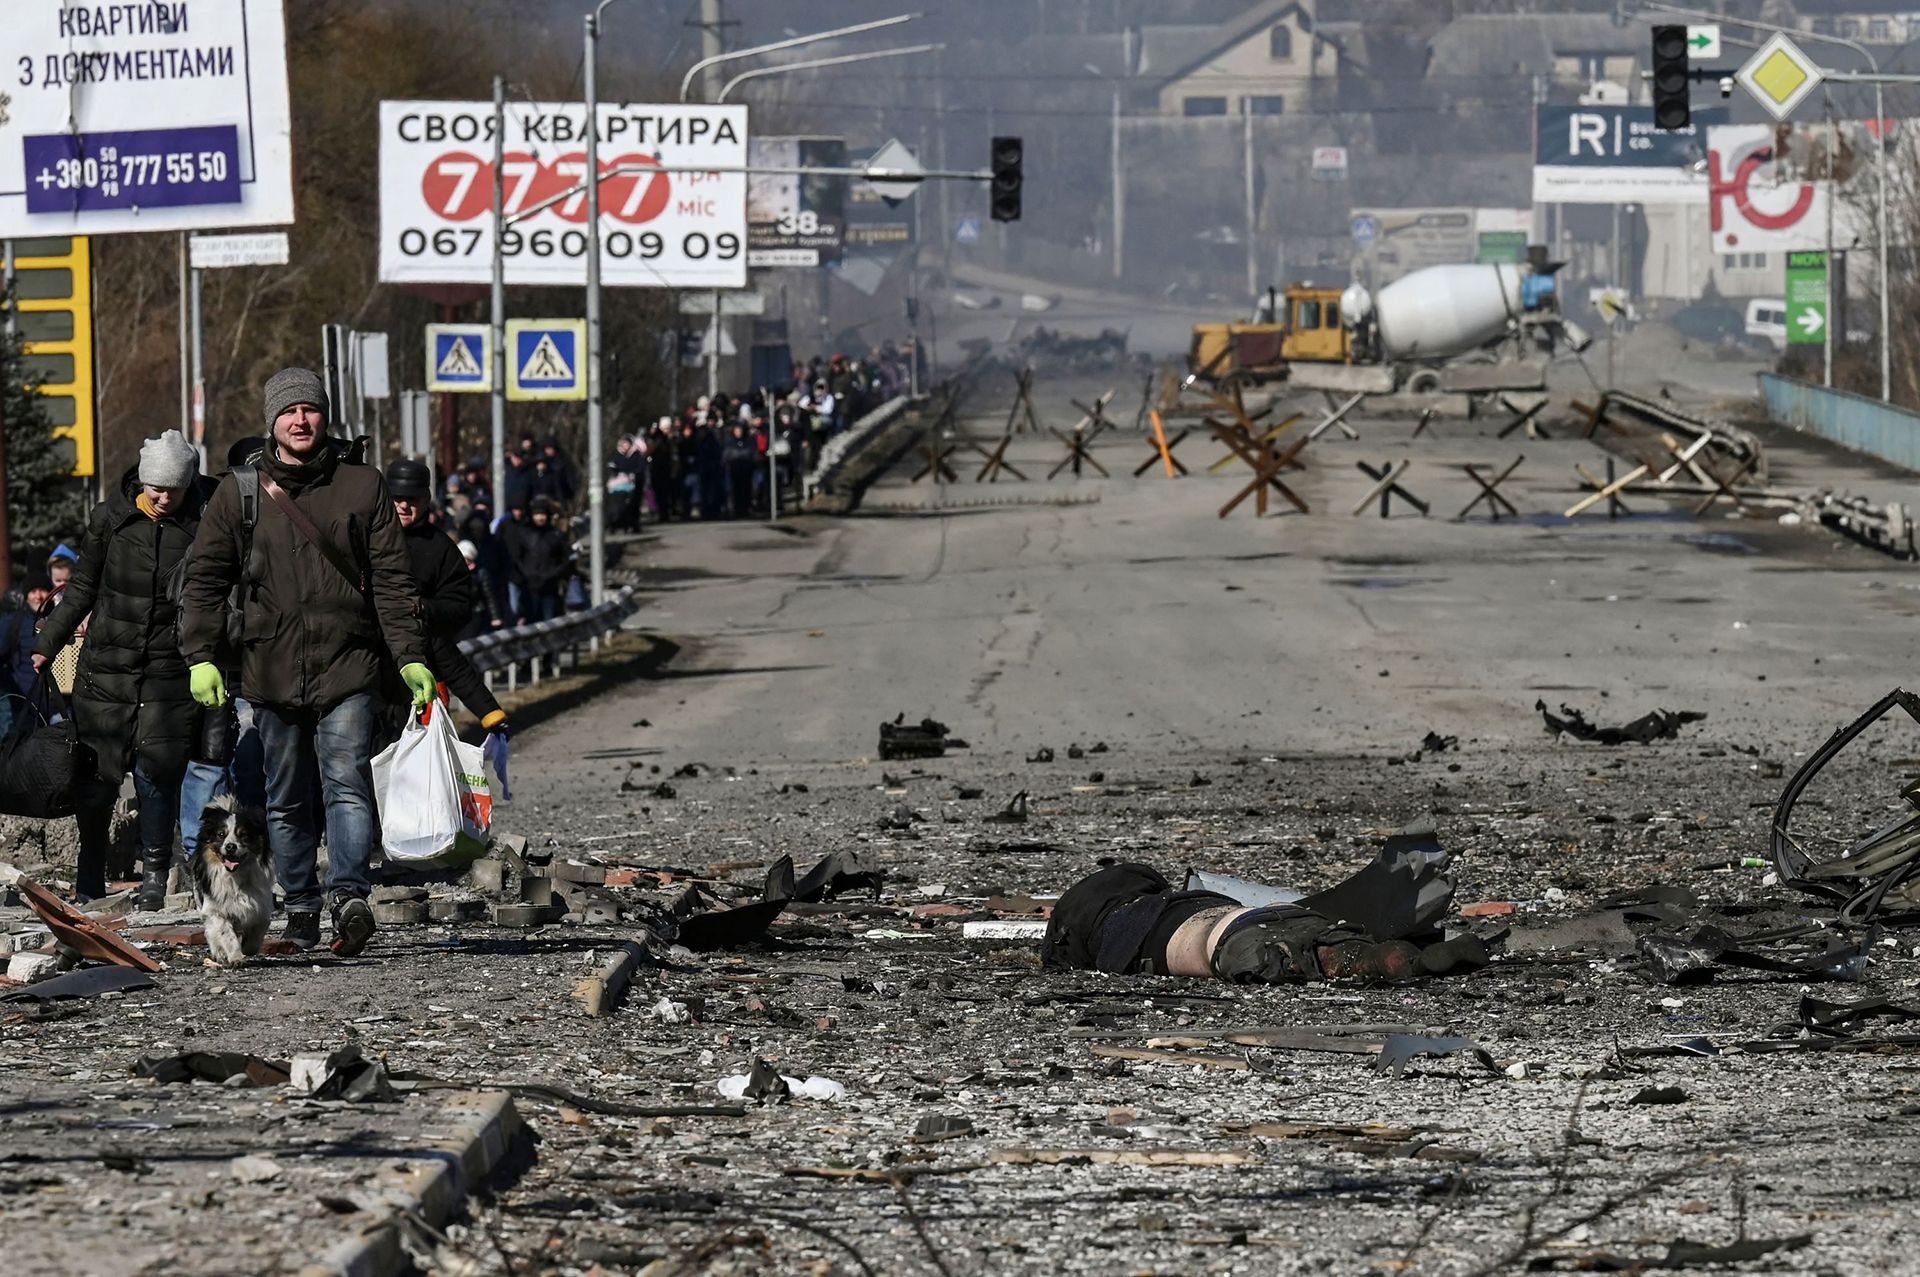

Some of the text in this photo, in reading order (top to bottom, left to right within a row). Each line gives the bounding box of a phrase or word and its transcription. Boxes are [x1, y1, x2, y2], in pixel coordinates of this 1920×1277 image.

[59, 2, 188, 37] КВАРТИРИ
[18, 46, 235, 89] З ДОКУМЕНТАМИ
[398, 114, 739, 145] СВОЯ КВАРТИРА
[1569, 112, 1607, 156] R
[100, 146, 117, 162] 50
[35, 150, 227, 190] +380 73 777 55 50
[101, 180, 119, 197] 98
[677, 198, 716, 216] міс
[399, 228, 740, 259] 067 960 09 09
